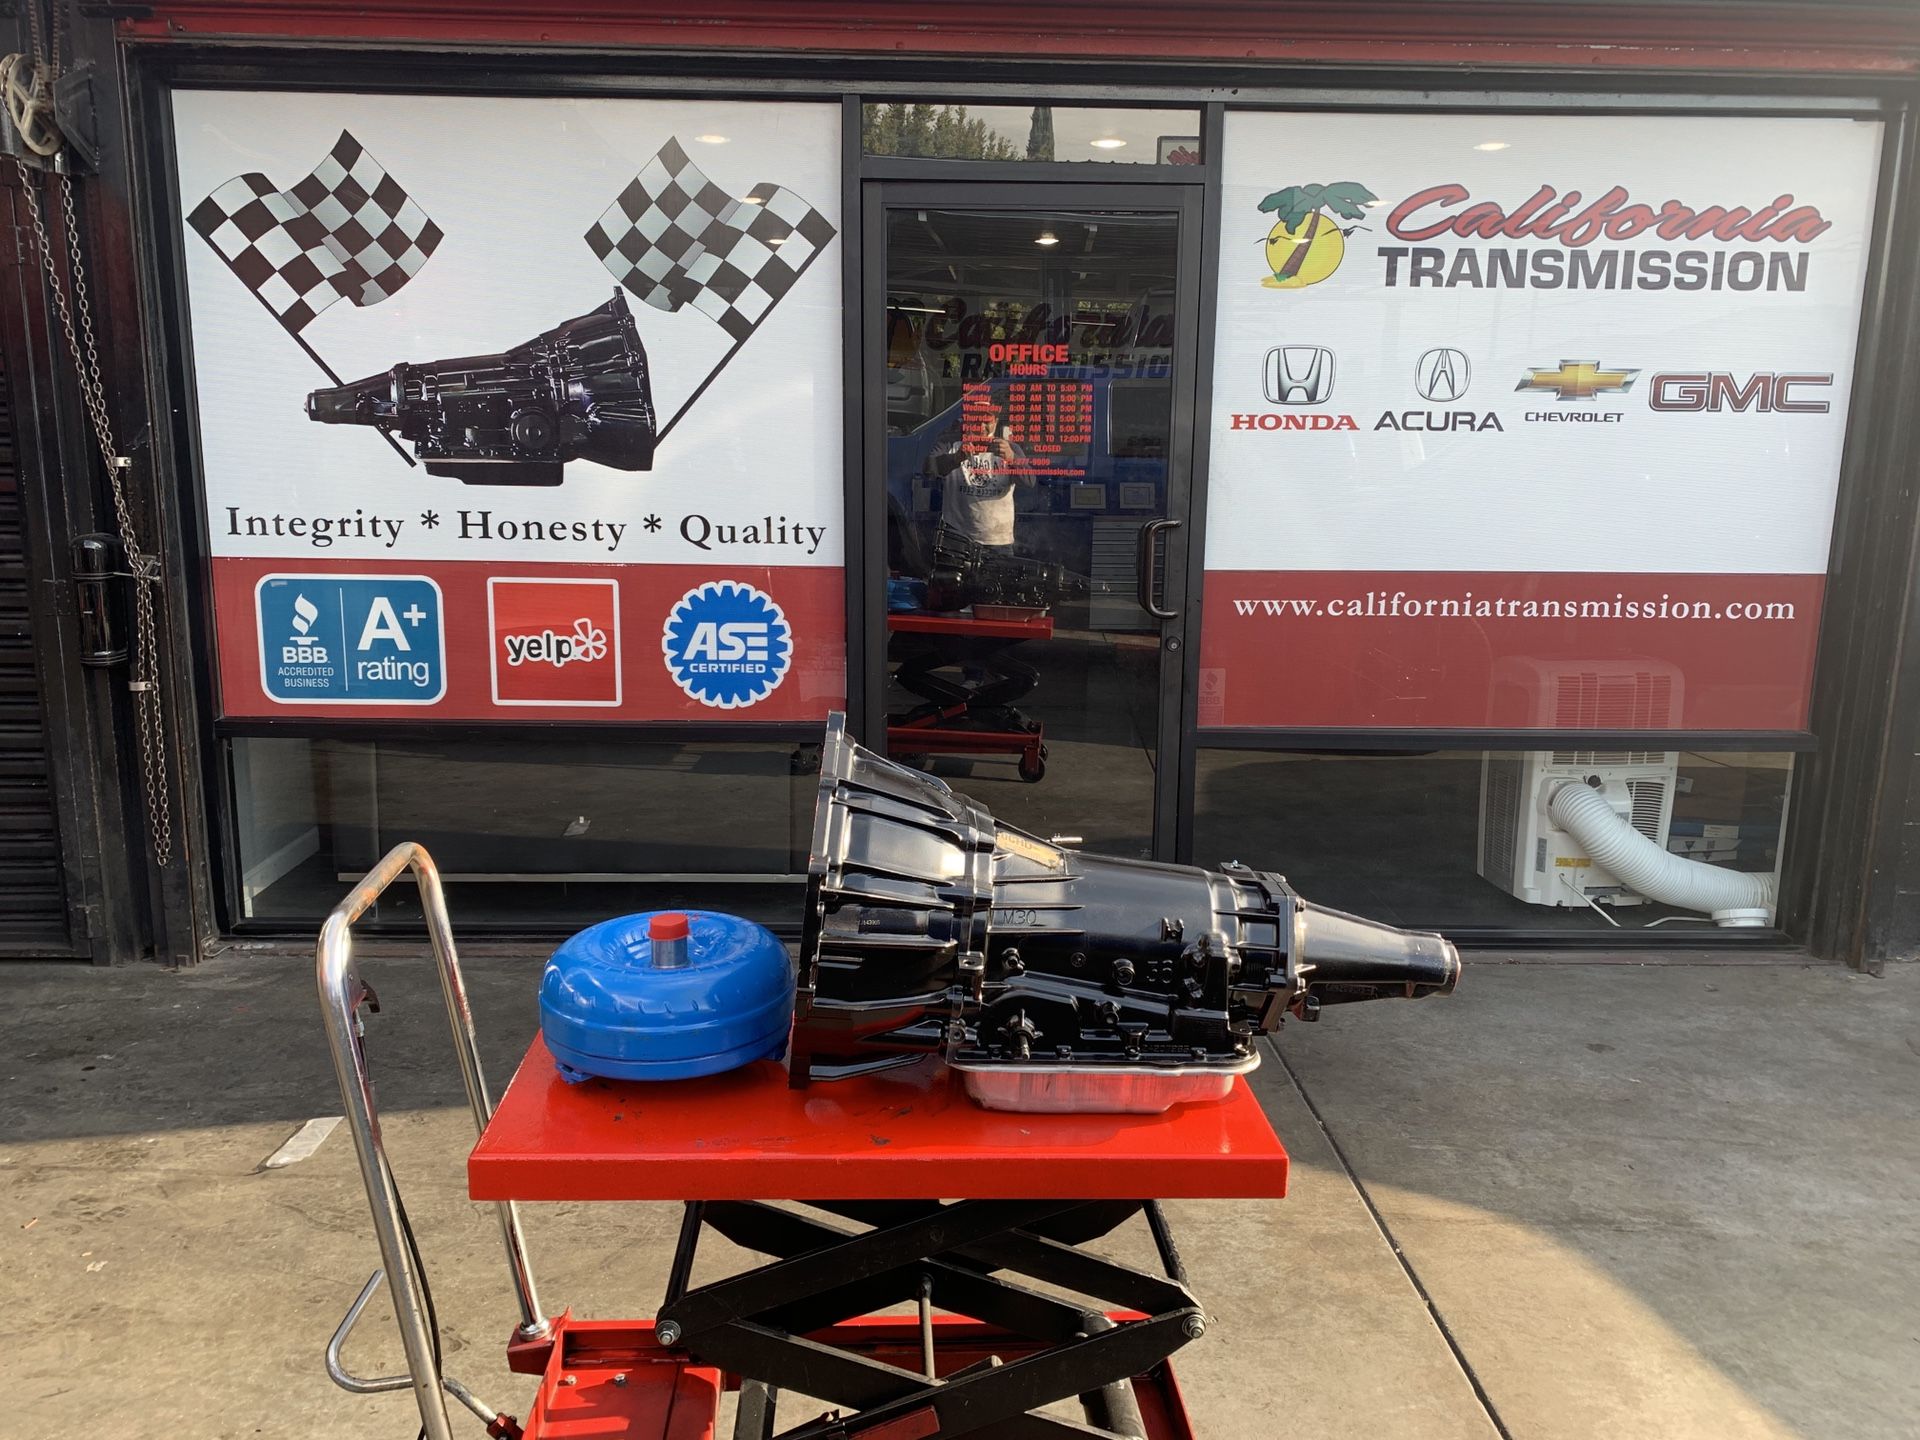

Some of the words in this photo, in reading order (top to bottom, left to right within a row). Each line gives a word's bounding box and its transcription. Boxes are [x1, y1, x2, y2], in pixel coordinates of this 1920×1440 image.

[1385, 183, 1833, 248] California
[1377, 246, 1810, 292] TRANSMISSION
[989, 343, 1070, 363] OFFICE
[1009, 363, 1048, 376] HOURS
[963, 384, 991, 393] Monday
[1648, 370, 1834, 413] GMC
[963, 394, 991, 403] Tuesday
[963, 404, 1002, 413] Wednesday
[963, 415, 995, 423] Thursday
[1231, 414, 1360, 431] HONDA
[1373, 411, 1505, 432] ACURA
[1524, 412, 1624, 423] CHEVROLET
[963, 425, 985, 433] Friday
[963, 435, 992, 443] Saturday
[225, 507, 404, 548] Integrity
[457, 510, 627, 552] Honesty
[680, 514, 827, 555] Quality
[1233, 591, 1796, 621] www.californiatransmission.com
[508, 633, 572, 664] yelp
[682, 622, 768, 661] ASE
[282, 646, 329, 663] BBB
[278, 667, 334, 676] ACCREDITED
[357, 656, 429, 687] rating
[689, 663, 766, 674] CERTIFIED
[284, 678, 330, 688] BUSINESS
